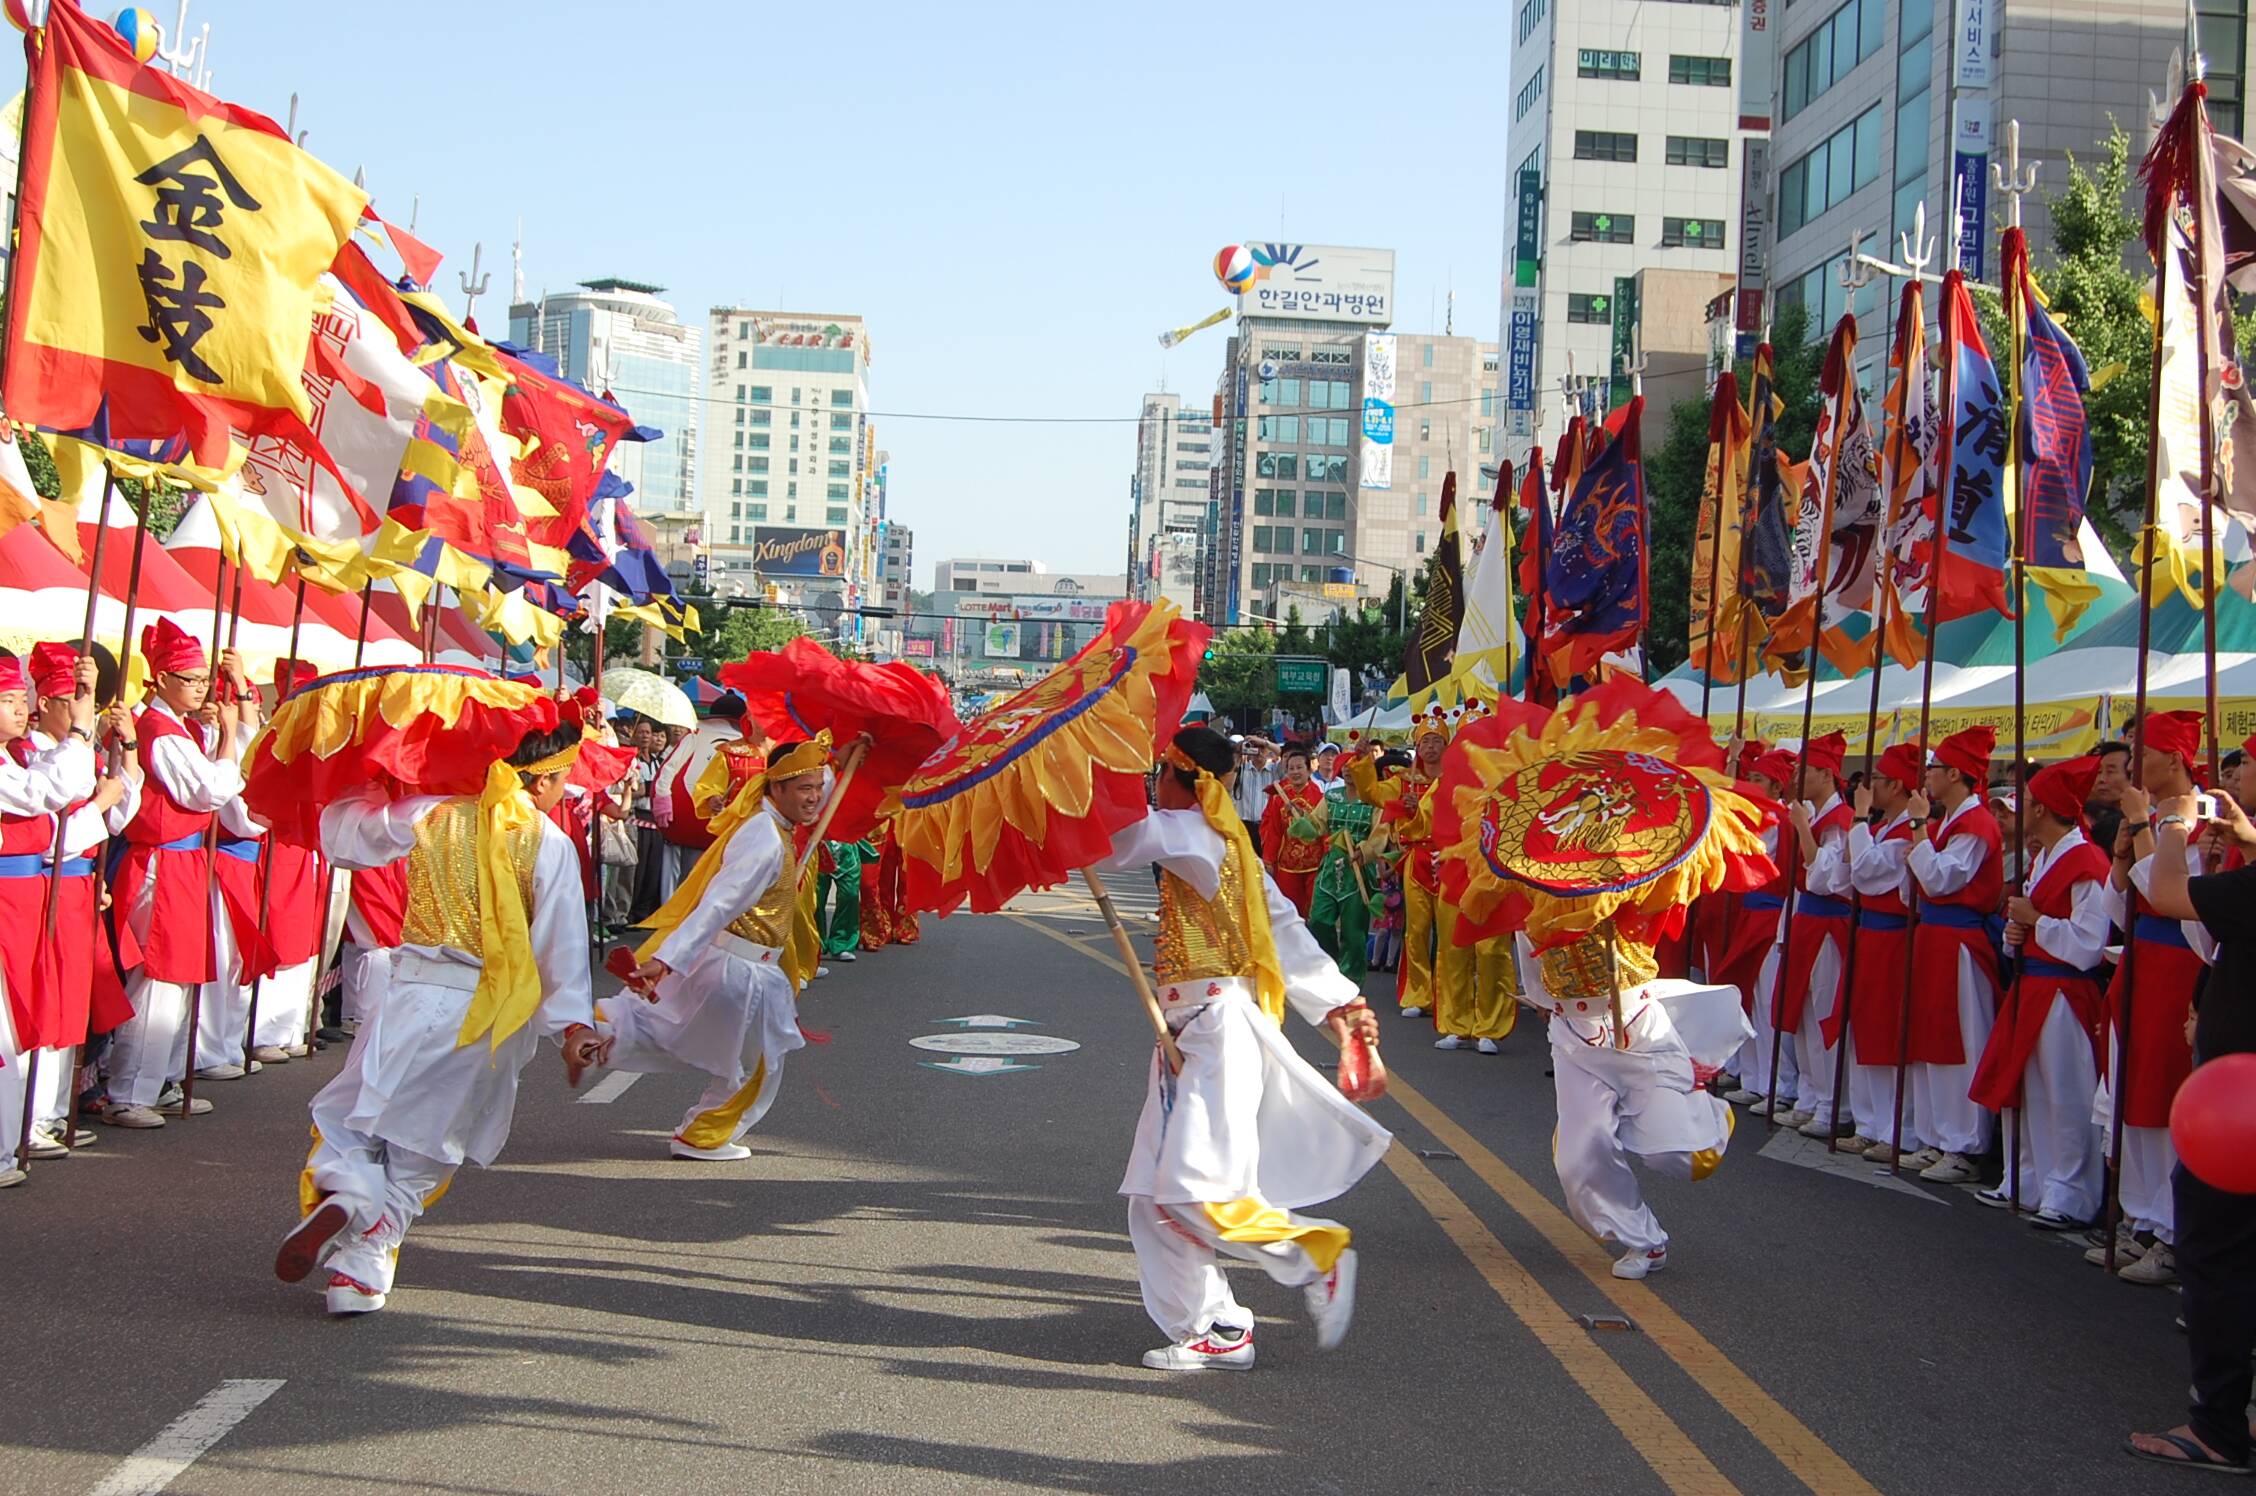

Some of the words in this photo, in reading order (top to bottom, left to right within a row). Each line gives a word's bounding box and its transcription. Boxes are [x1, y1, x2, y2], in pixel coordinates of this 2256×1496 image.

[1967, 0, 1982, 63] 서비스
[1258, 288, 1385, 316] 한길안과병원
[754, 533, 829, 563] Kingdom
[960, 603, 987, 612] LOTTE
[988, 602, 1011, 612] Mart
